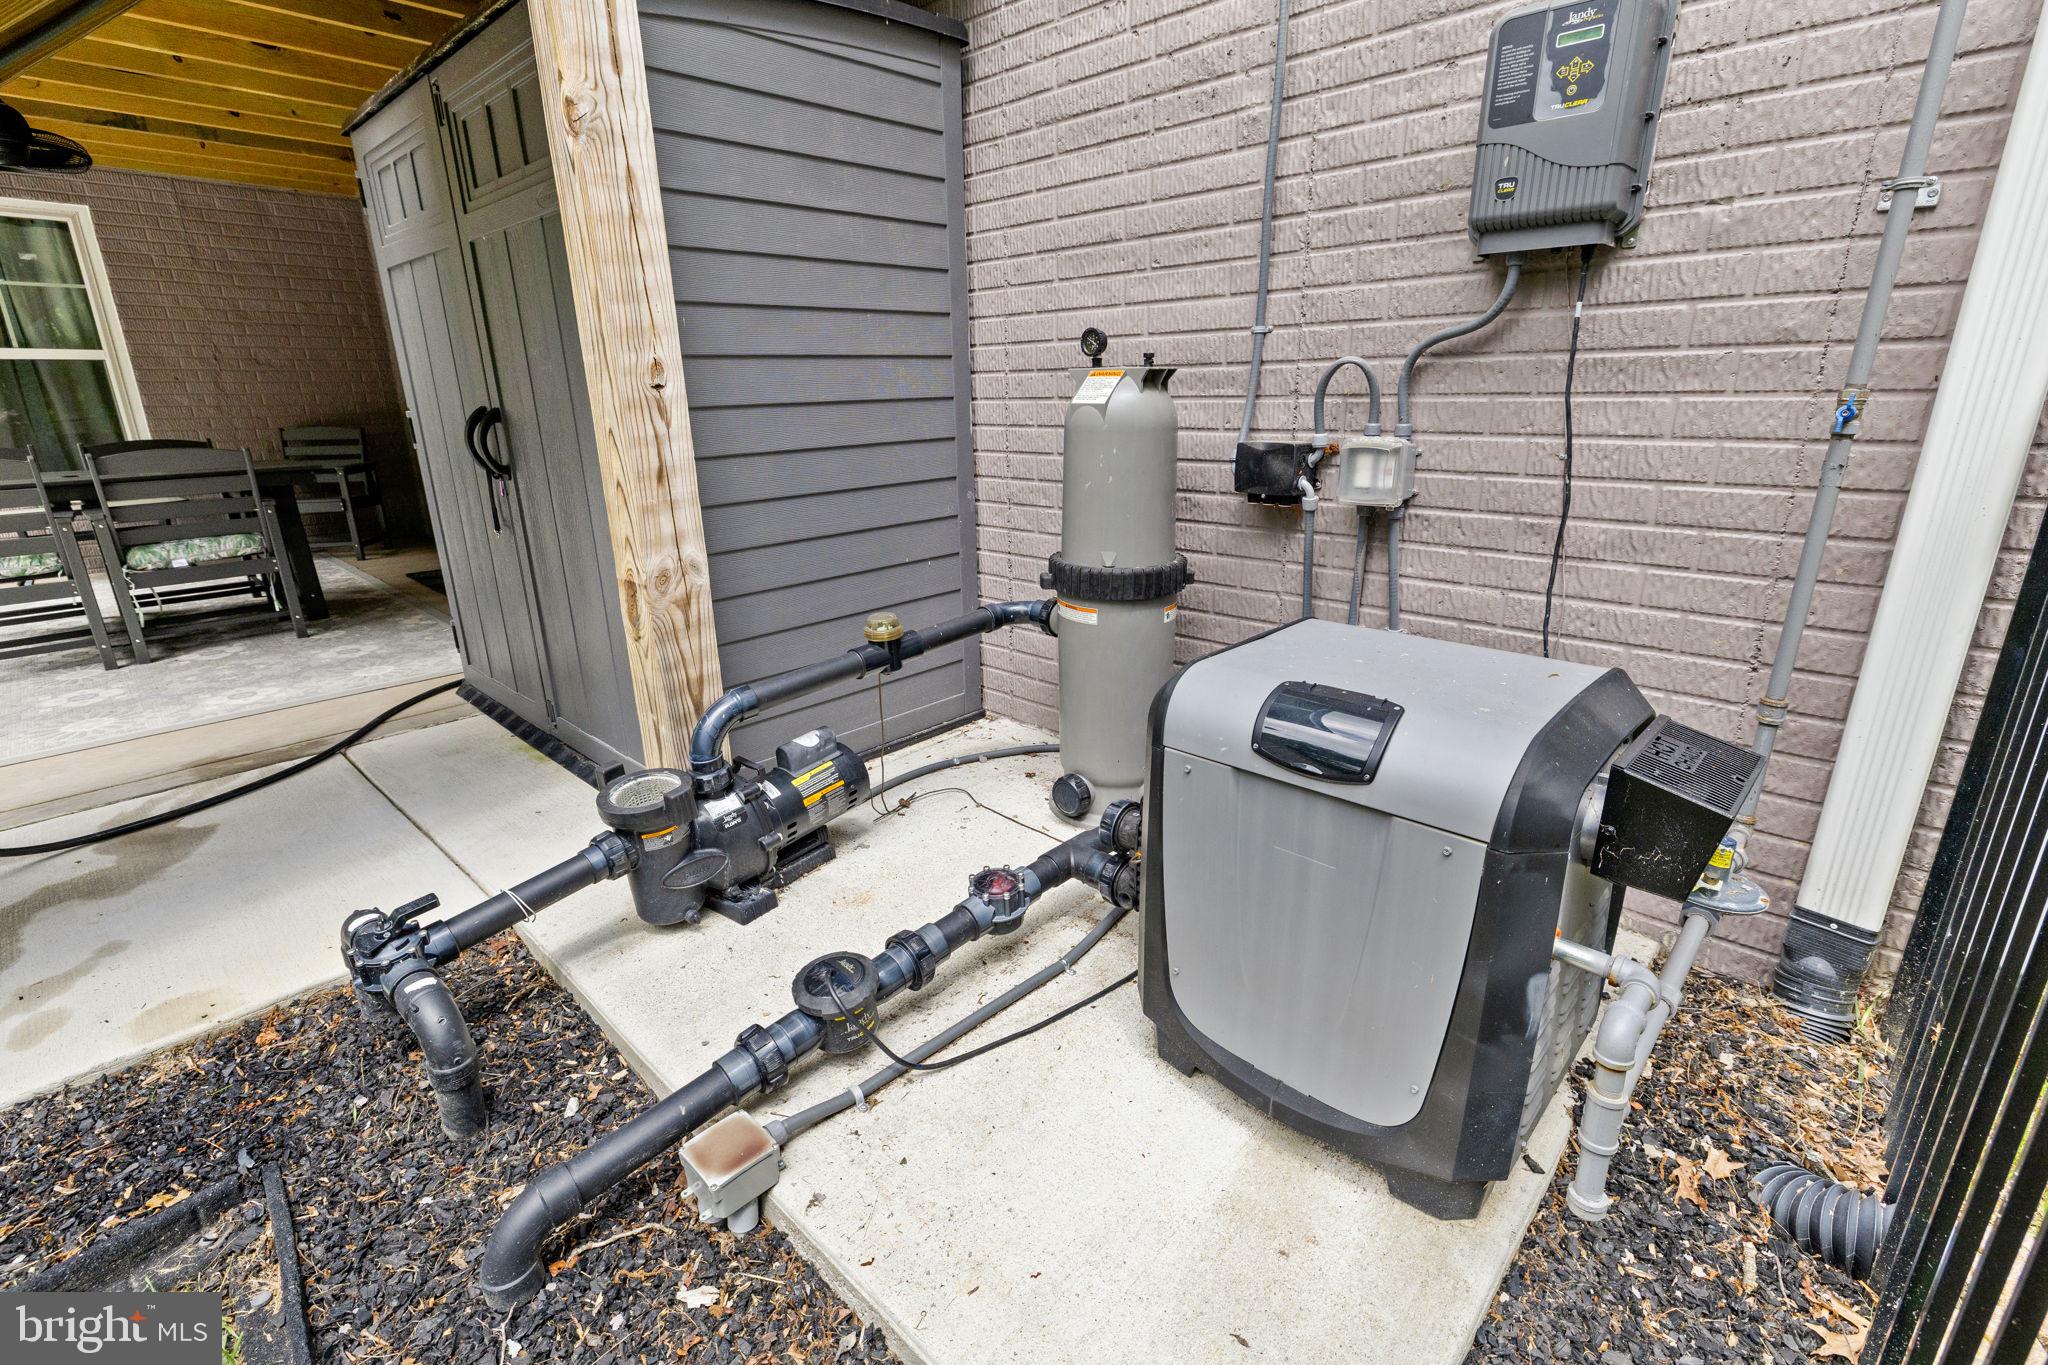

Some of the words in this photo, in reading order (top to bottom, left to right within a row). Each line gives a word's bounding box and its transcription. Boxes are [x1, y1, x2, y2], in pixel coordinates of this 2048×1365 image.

[1568, 7, 1597, 24] Jandy
[1498, 181, 1515, 189] TRU
[1644, 736, 1680, 761] HOT
